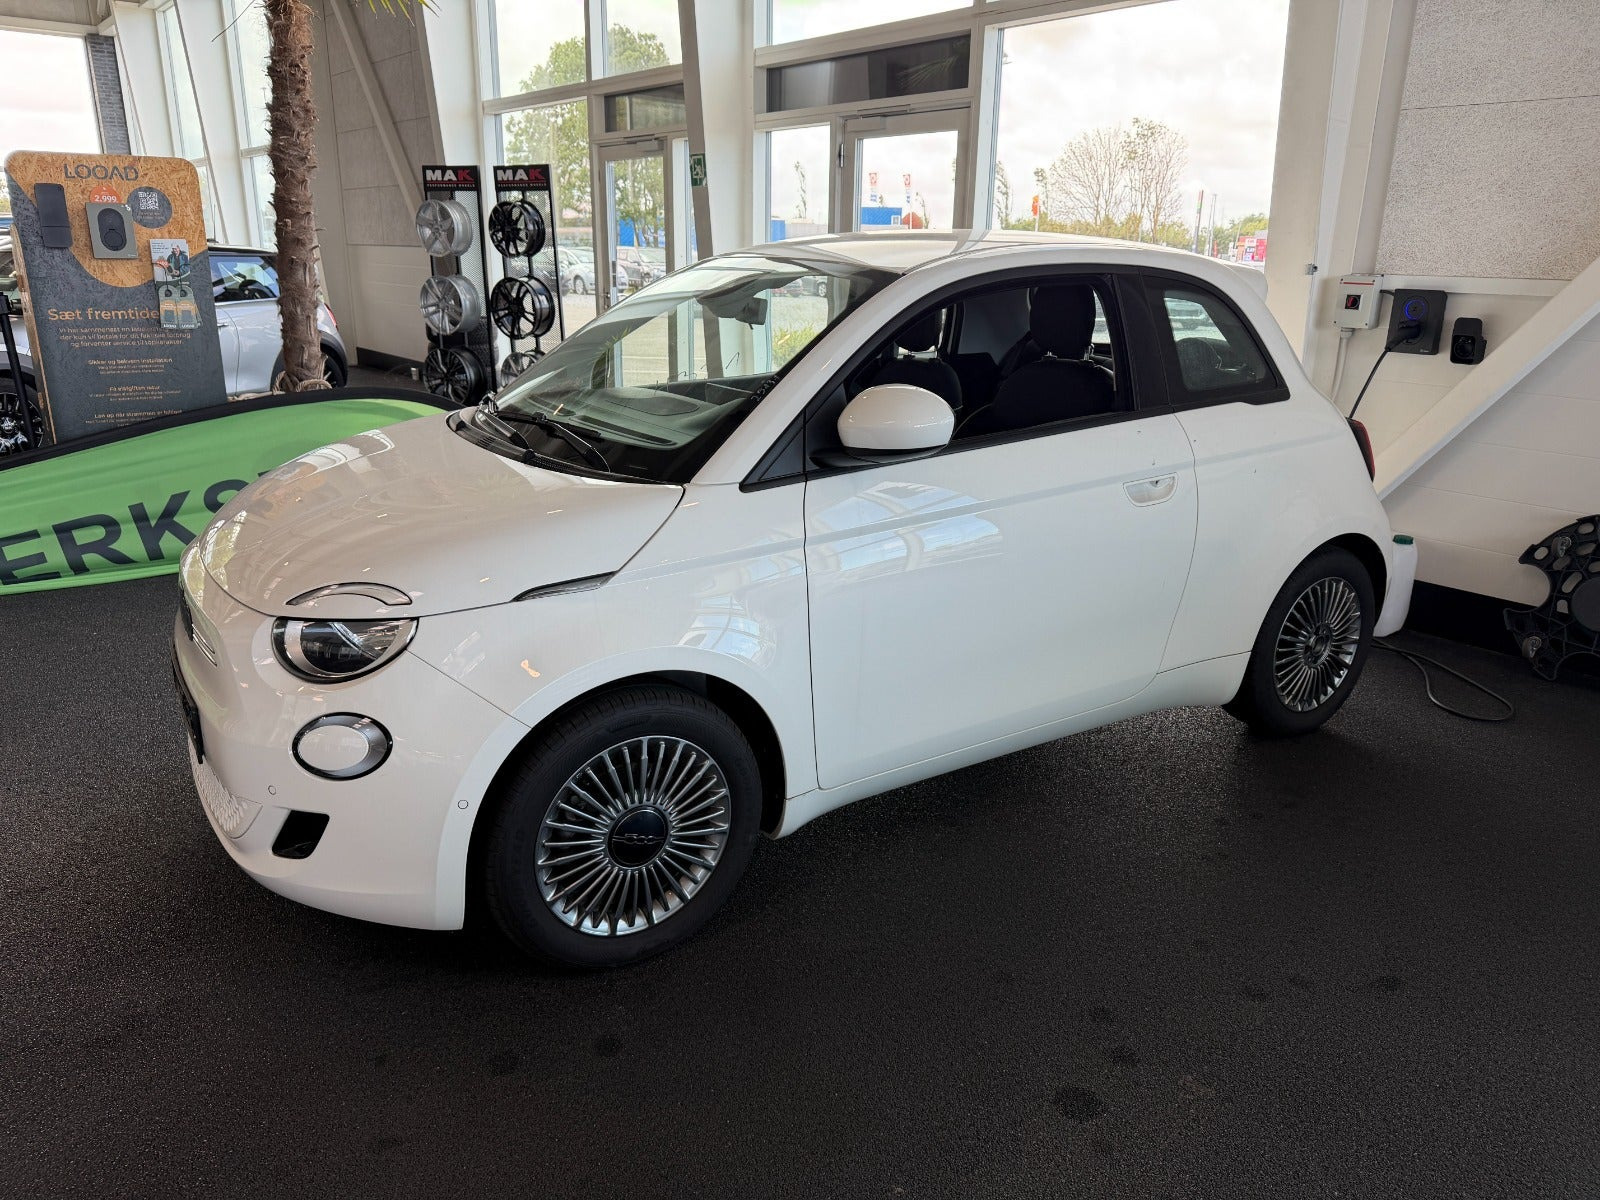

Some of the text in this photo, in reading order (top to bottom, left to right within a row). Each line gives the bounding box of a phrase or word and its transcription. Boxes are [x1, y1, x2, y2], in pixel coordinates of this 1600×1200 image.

[63, 163, 139, 181] LOOAD
[426, 169, 474, 181] MAK
[497, 168, 545, 181] MAK
[47, 307, 160, 321] Sæt fremtide
